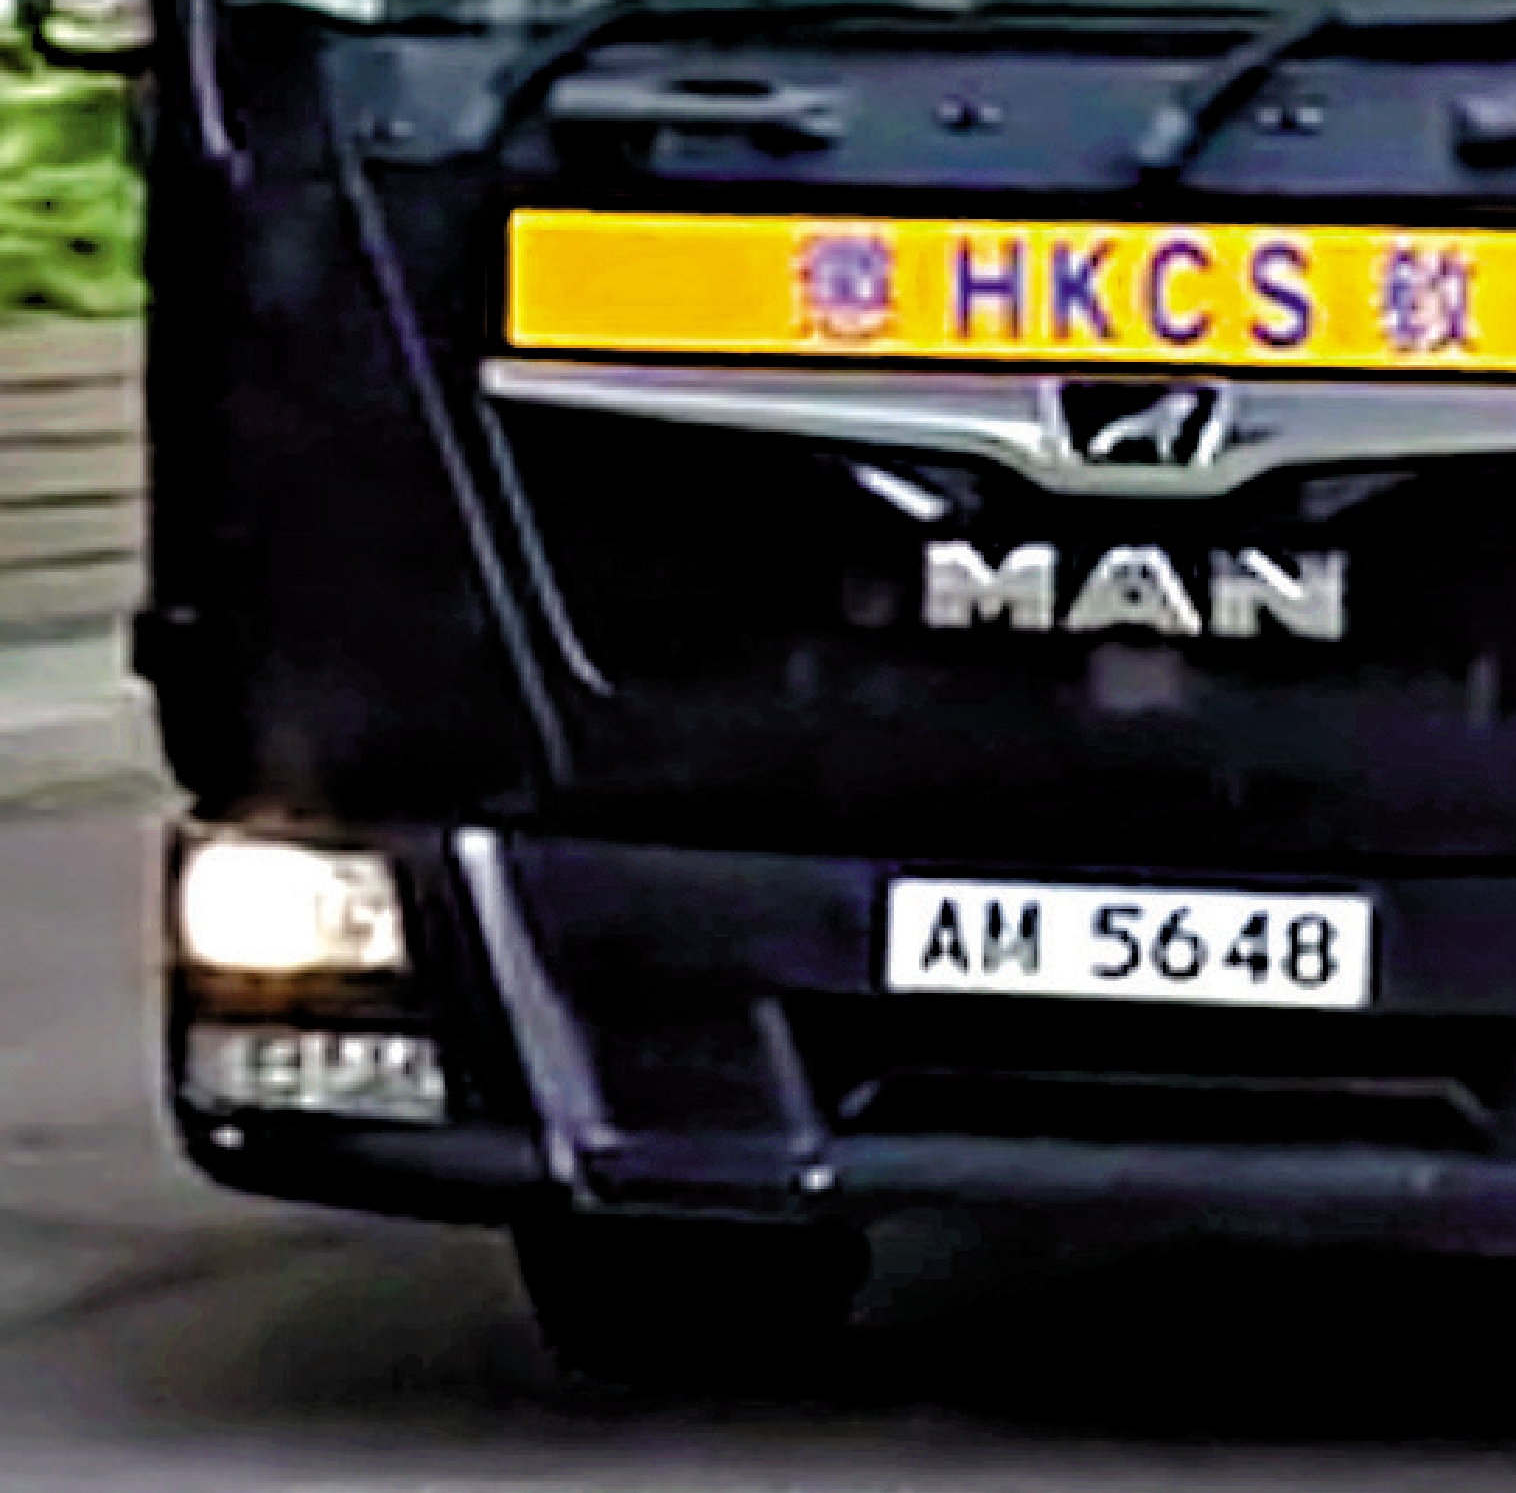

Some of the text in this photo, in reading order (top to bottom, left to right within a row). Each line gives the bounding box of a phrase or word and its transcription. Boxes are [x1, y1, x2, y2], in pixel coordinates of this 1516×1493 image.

[956, 238, 1315, 347] HKCS
[923, 540, 1348, 640] MAN
[920, 897, 1338, 989] AM 5648
